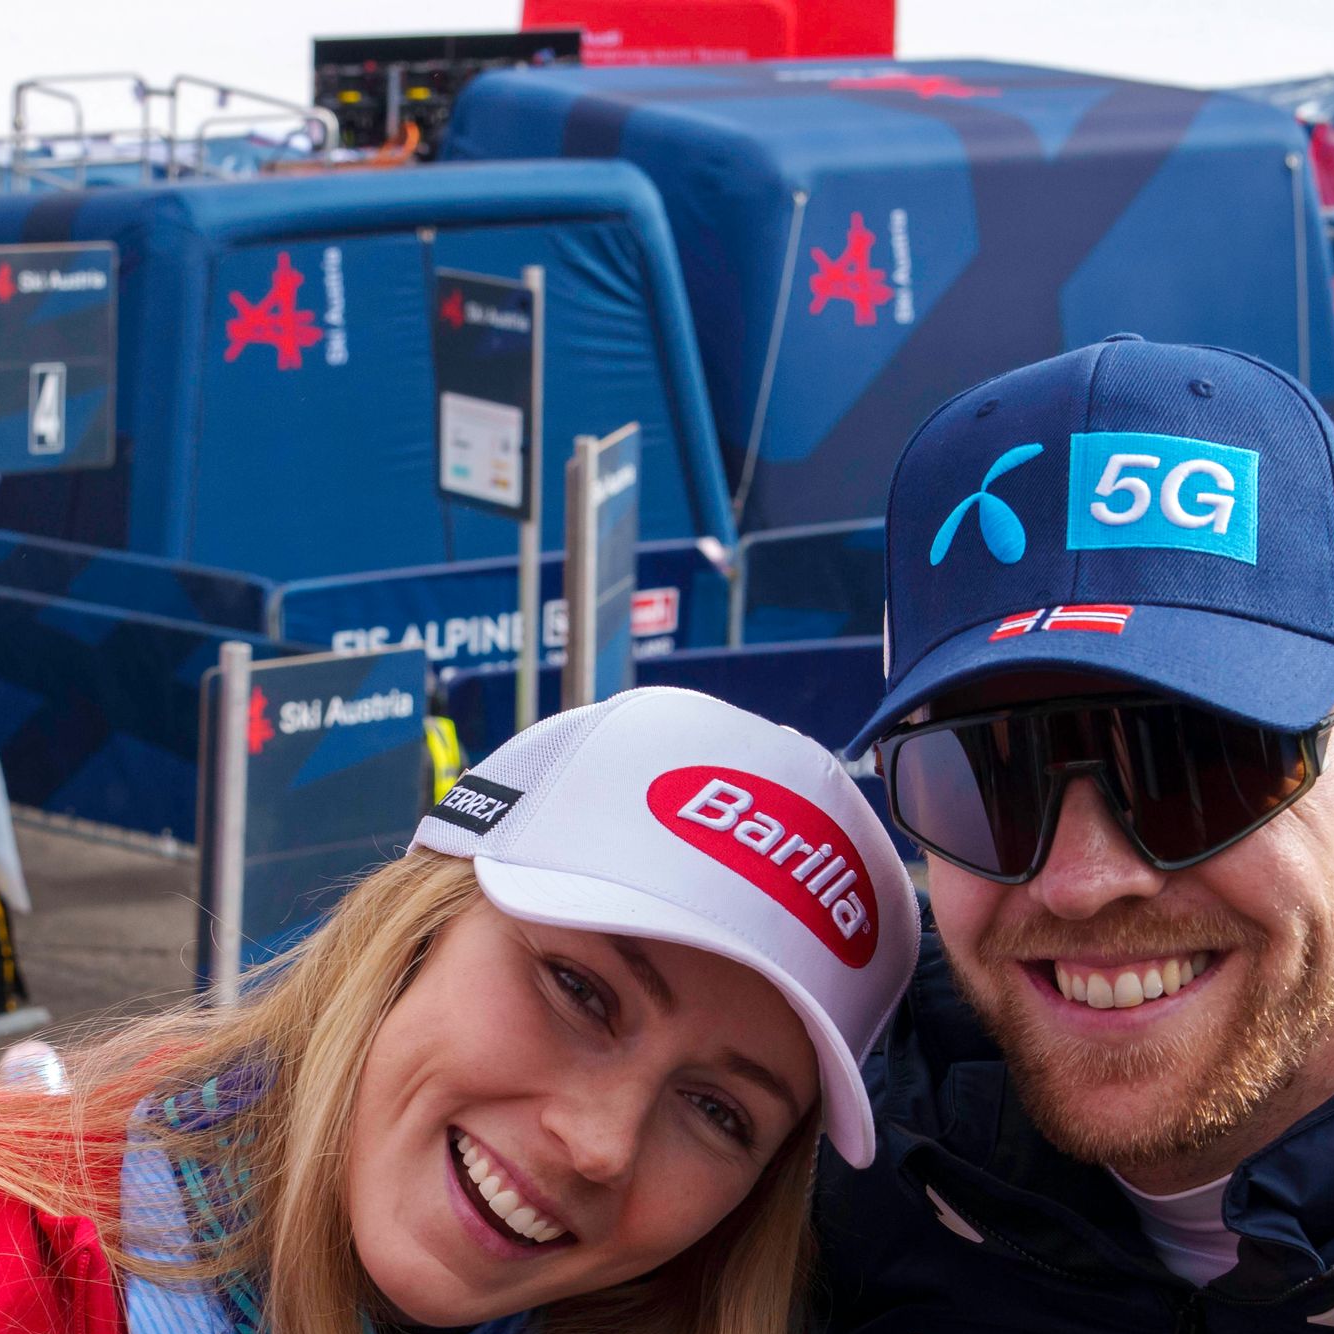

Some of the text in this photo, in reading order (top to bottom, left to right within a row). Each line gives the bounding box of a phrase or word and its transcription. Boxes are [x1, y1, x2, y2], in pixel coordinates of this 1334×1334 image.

[1090, 453, 1236, 535] 5G
[279, 688, 414, 734] Ski Austria
[438, 785, 509, 823] TERREX
[676, 777, 868, 940] Barilla
